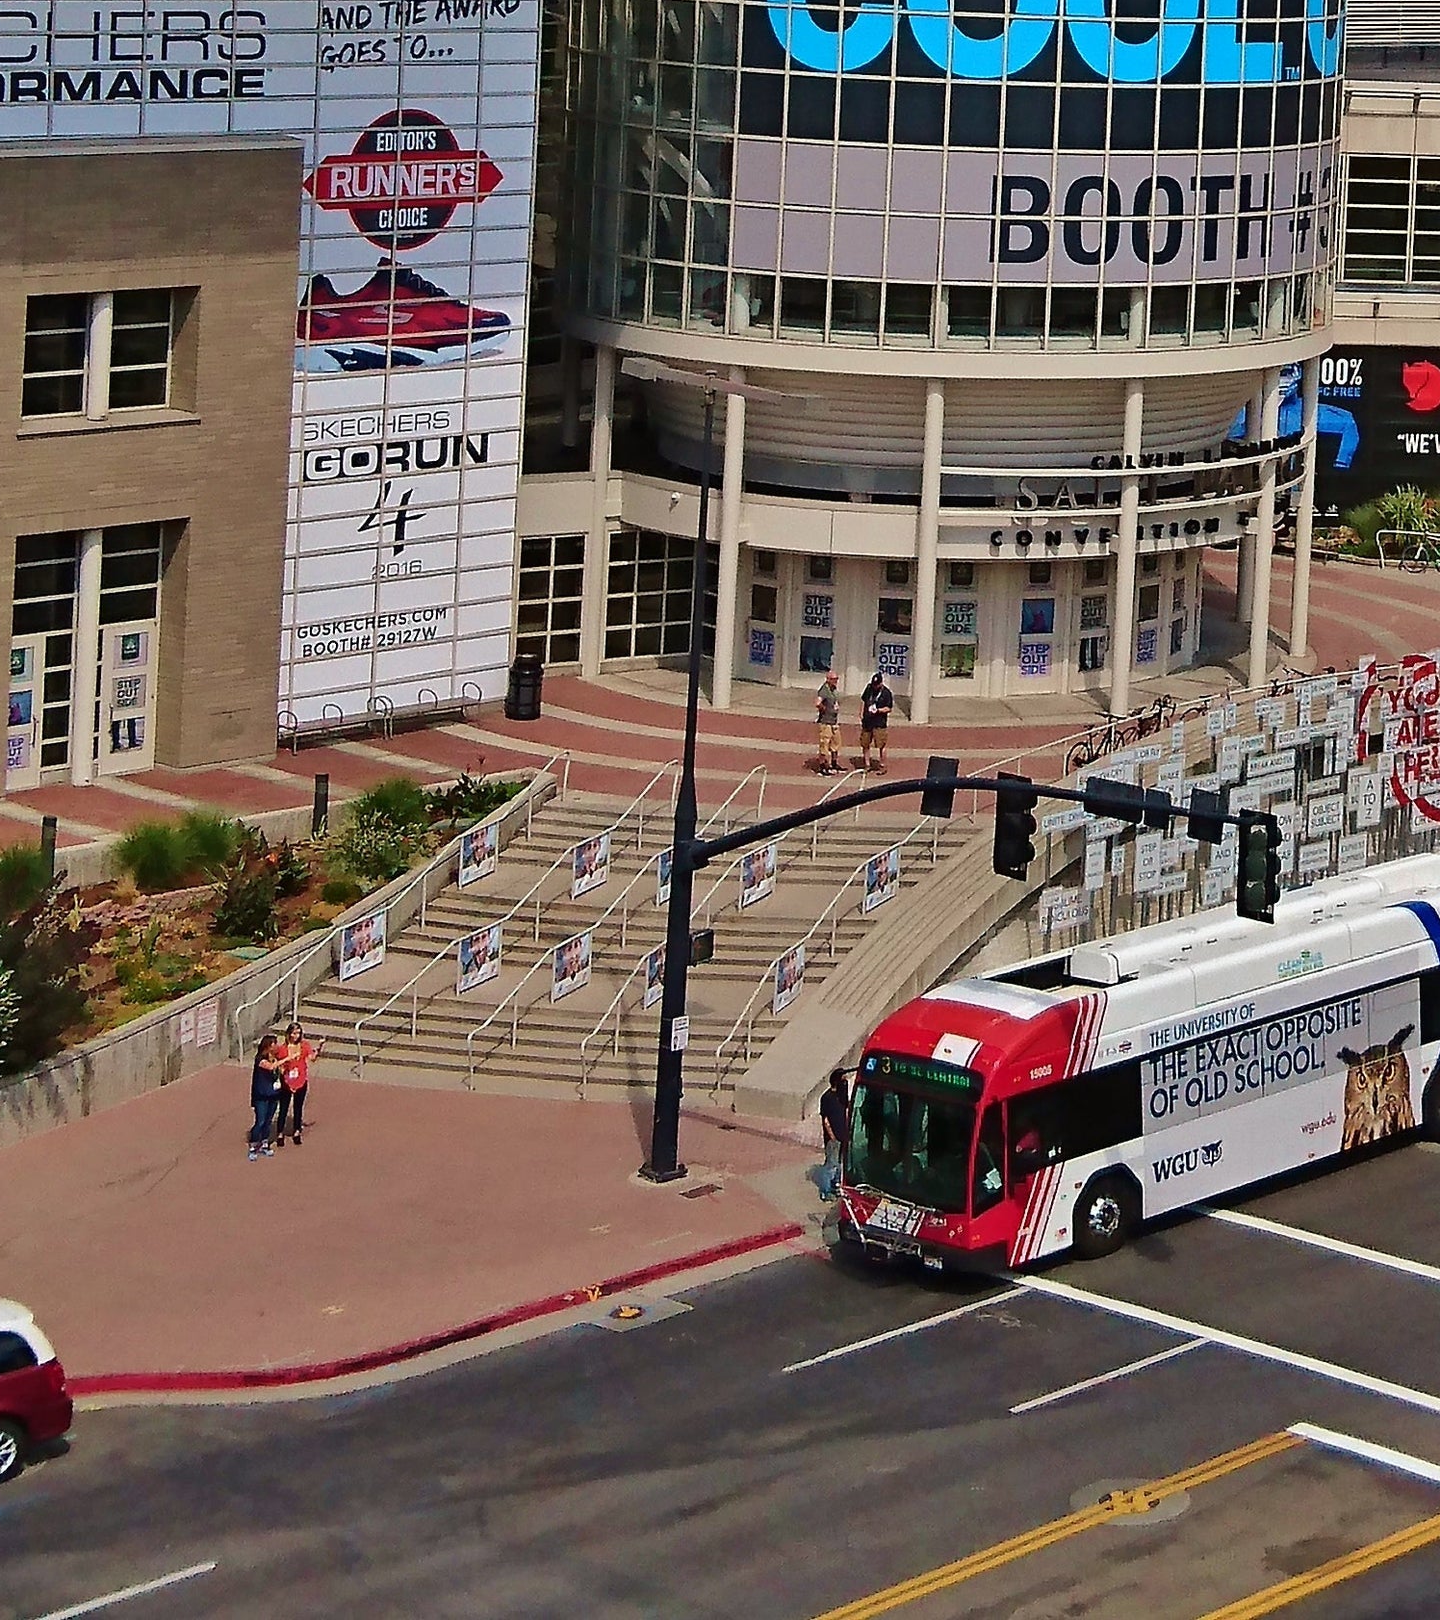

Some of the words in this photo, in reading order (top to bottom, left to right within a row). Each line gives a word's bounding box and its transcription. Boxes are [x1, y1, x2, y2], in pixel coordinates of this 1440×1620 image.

[321, 4, 372, 37] AND
[320, 38, 386, 73] GOES
[376, 131, 437, 152] EDITOR'S
[330, 162, 477, 199] RUNNER'S
[378, 207, 428, 229] CHOICE
[991, 171, 1273, 267] BOOTH
[304, 410, 451, 442] SKECHERS
[303, 432, 490, 482] GORUN
[356, 479, 428, 557] 4
[805, 594, 833, 606] STEP
[804, 605, 831, 617] OUT
[945, 602, 975, 613] STEP
[296, 607, 448, 639] GOSKECHERS.COM
[804, 616, 829, 628] SIDE
[944, 613, 972, 624] OUT
[944, 623, 971, 634] SIDE
[302, 635, 371, 658] BOOTH#
[376, 624, 438, 648] 29127W
[879, 643, 909, 655] STEP
[1021, 644, 1050, 655] STEP
[878, 654, 907, 665] OUT
[1021, 654, 1048, 665] OUT
[878, 665, 905, 676] SIDE
[1020, 664, 1047, 676] SIDE
[117, 679, 142, 689] STEP
[117, 688, 139, 698] OUT
[117, 697, 138, 708] SIDE
[7, 737, 25, 748] TEP
[8, 747, 23, 757] UT
[1366, 780, 1374, 789] A
[1362, 792, 1376, 805] TO
[1312, 801, 1340, 816] OBJECT
[1149, 1030, 1170, 1048] THE
[1173, 1006, 1238, 1040] UNIVERSITY
[1239, 1002, 1257, 1021] OF
[1148, 1046, 1188, 1087] THE
[1195, 1029, 1261, 1073] EXACT
[1265, 998, 1362, 1051] OPPOSITE
[1149, 1083, 1179, 1118] OF
[1185, 1070, 1228, 1108] OLD
[1234, 1042, 1326, 1093] SCHOOL.
[1300, 1111, 1337, 1135] wgu.edu
[1152, 1147, 1199, 1183] WGU
